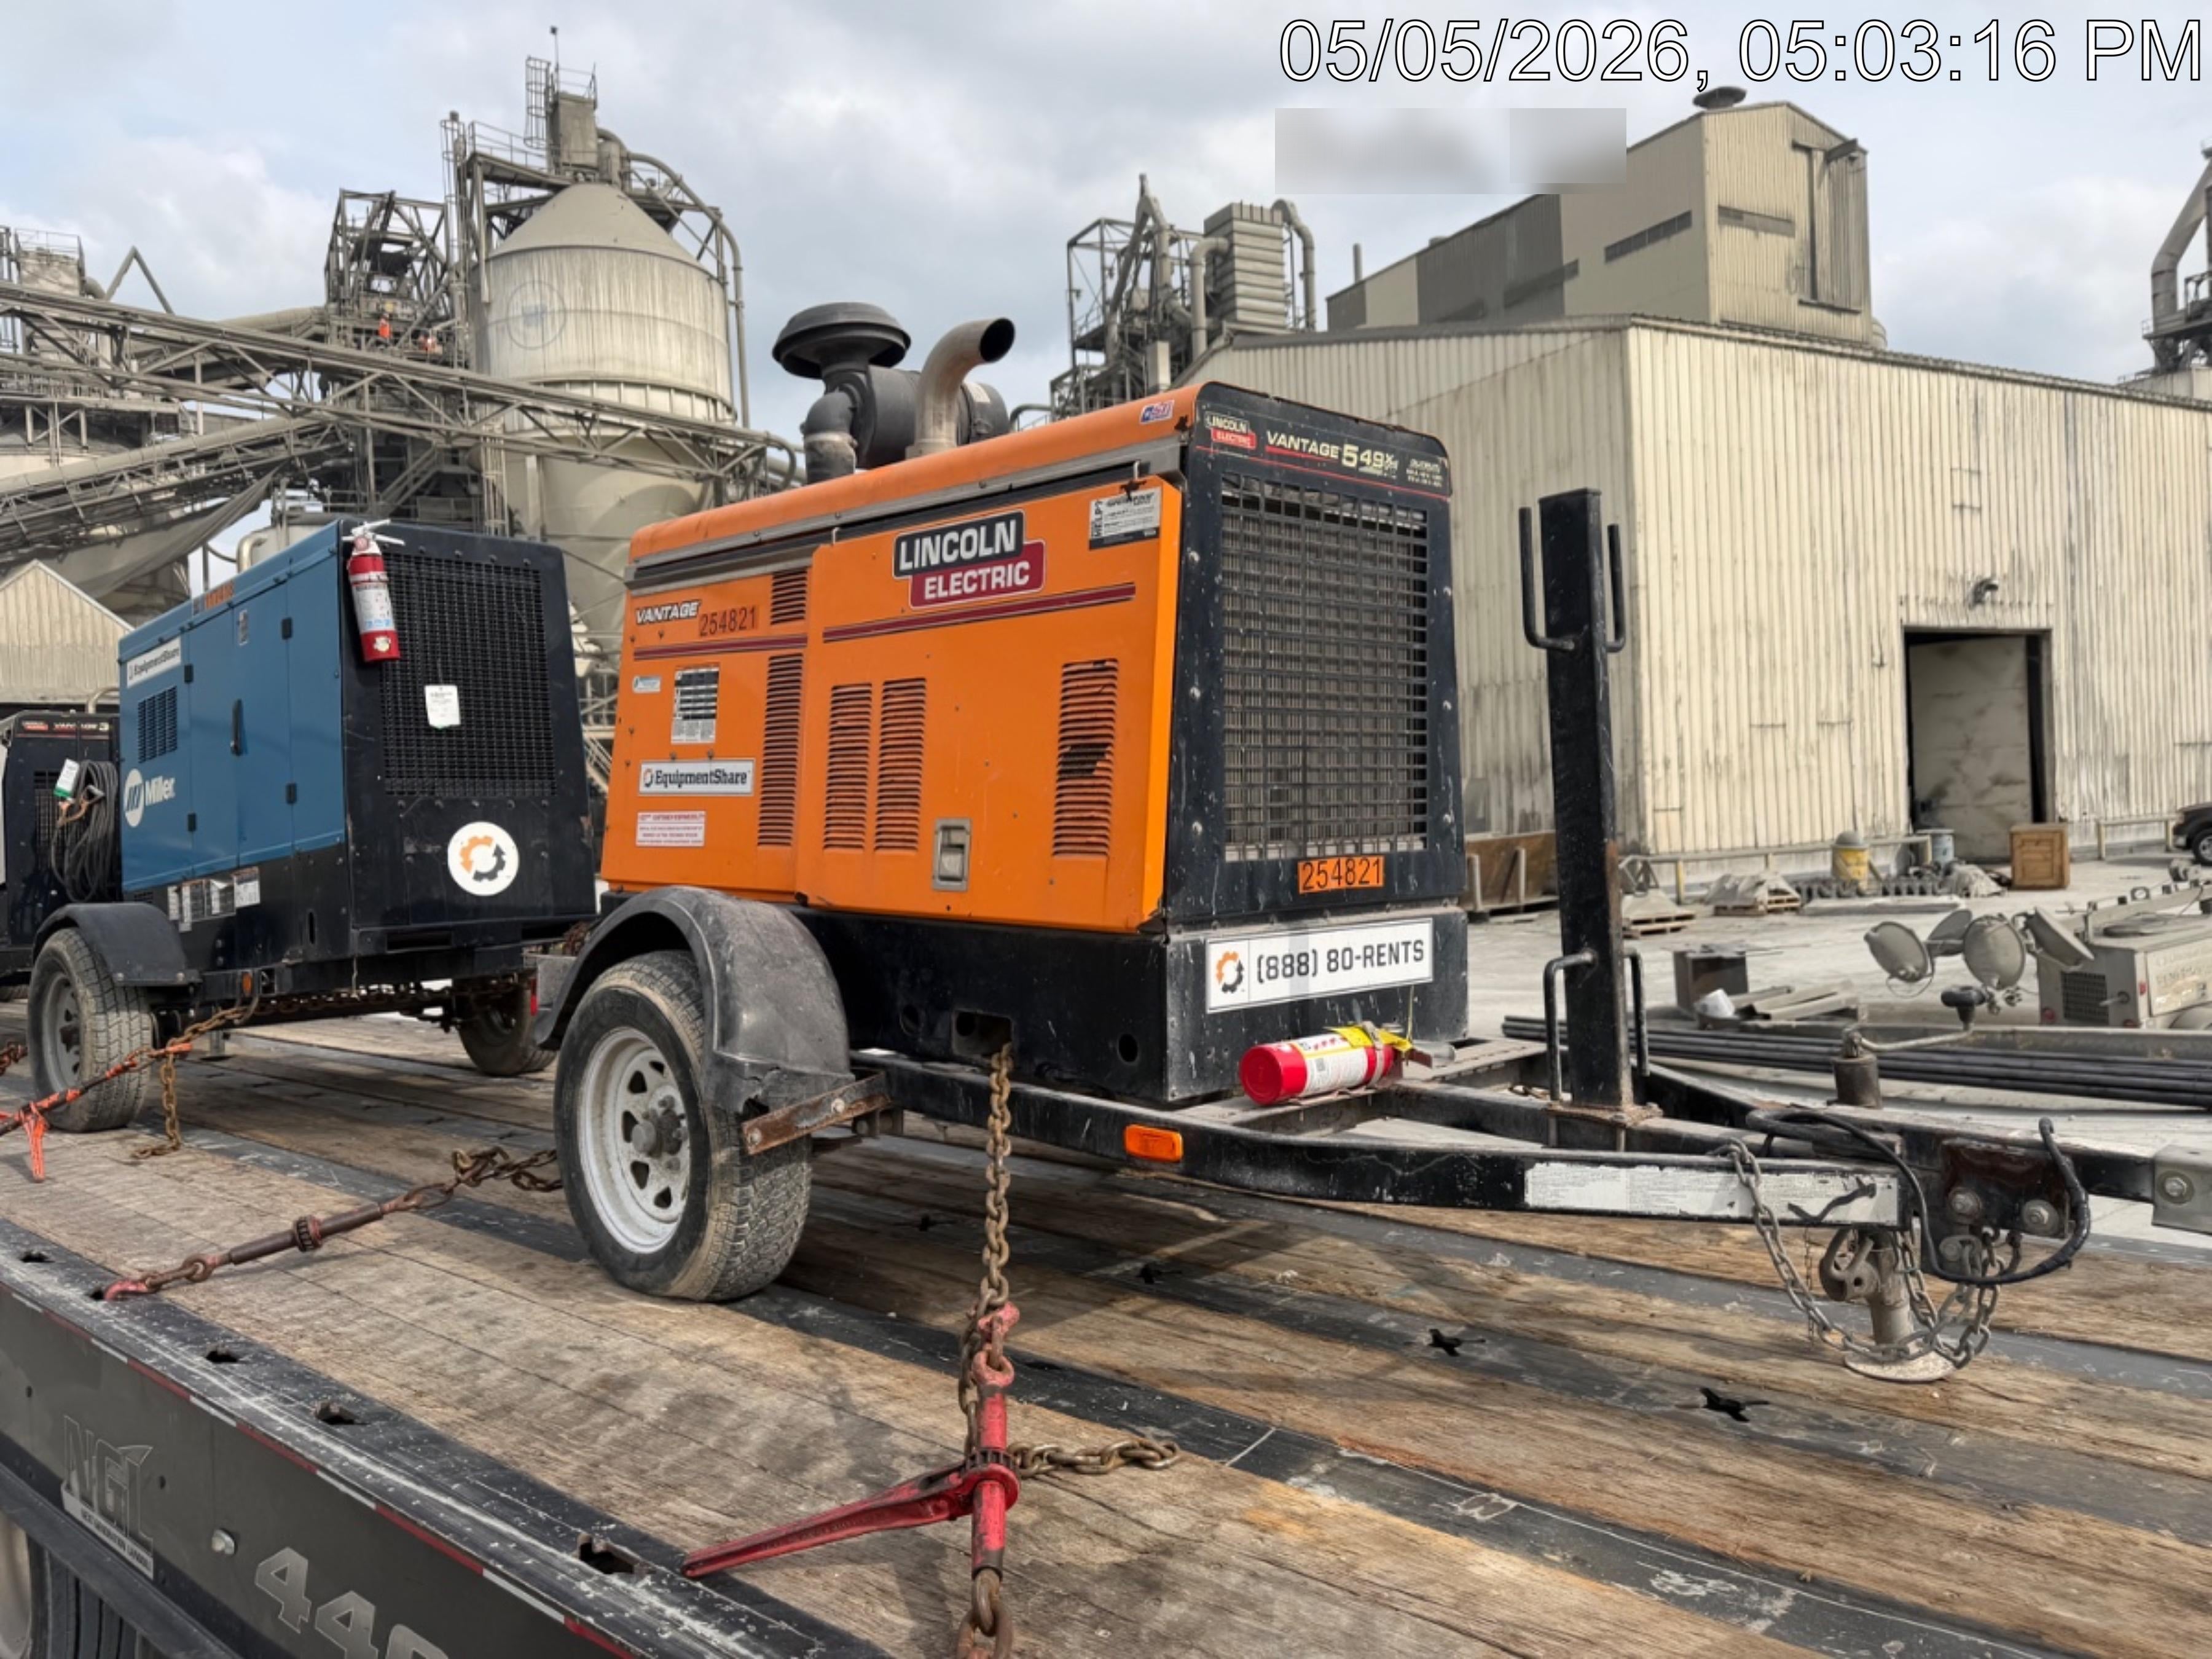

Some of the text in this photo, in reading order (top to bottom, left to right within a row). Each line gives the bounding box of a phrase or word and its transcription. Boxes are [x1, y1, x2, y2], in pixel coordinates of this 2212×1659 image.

[1207, 414, 1248, 434] LINCOLN
[1266, 430, 1339, 459] VANTAGE
[899, 519, 1016, 571] LINCOLN
[924, 561, 1030, 600] ELECTRIC
[635, 600, 701, 625] VANTAGE
[699, 606, 758, 637] 254821
[145, 775, 176, 806] Miller
[654, 769, 747, 788] EquipmentShare
[1302, 858, 1382, 891] 254821
[1257, 939, 1424, 984] (888) 80-RENTS
